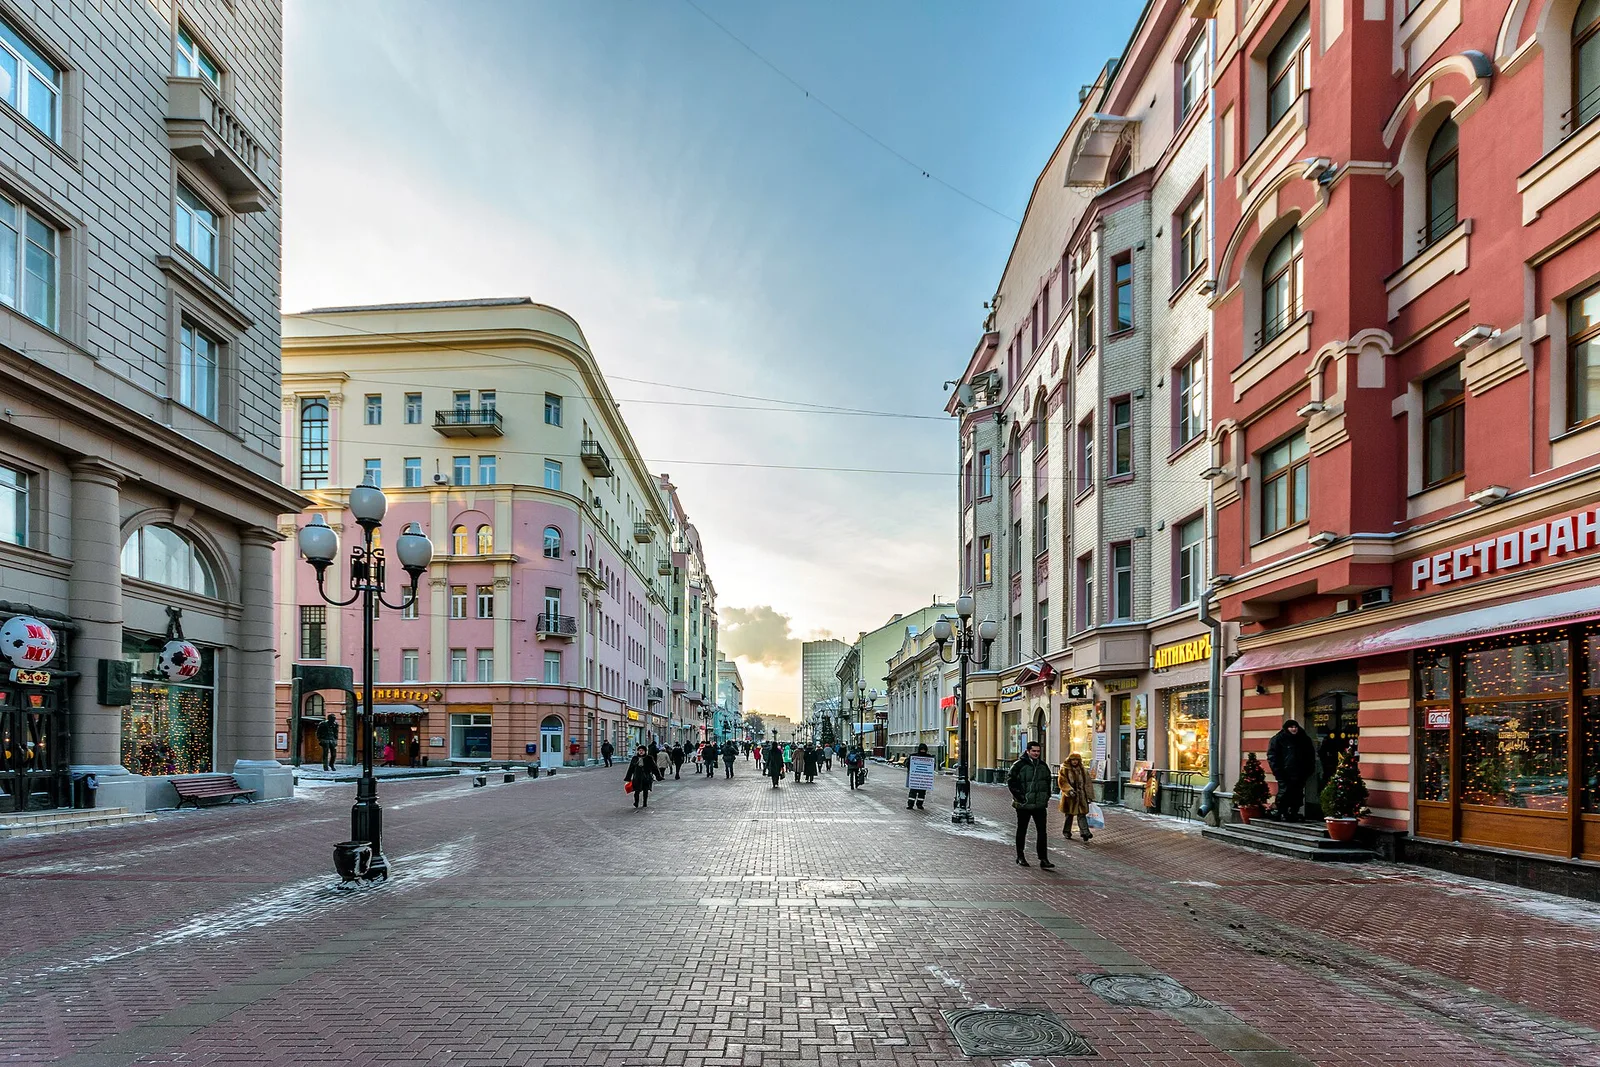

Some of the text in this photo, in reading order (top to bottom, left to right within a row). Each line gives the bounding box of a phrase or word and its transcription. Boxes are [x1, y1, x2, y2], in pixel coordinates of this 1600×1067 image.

[1412, 508, 1600, 590] РЕСТОРАН
[18, 673, 48, 682] КАФЕ
[356, 688, 429, 702] ОТМЕЙСТЕР
